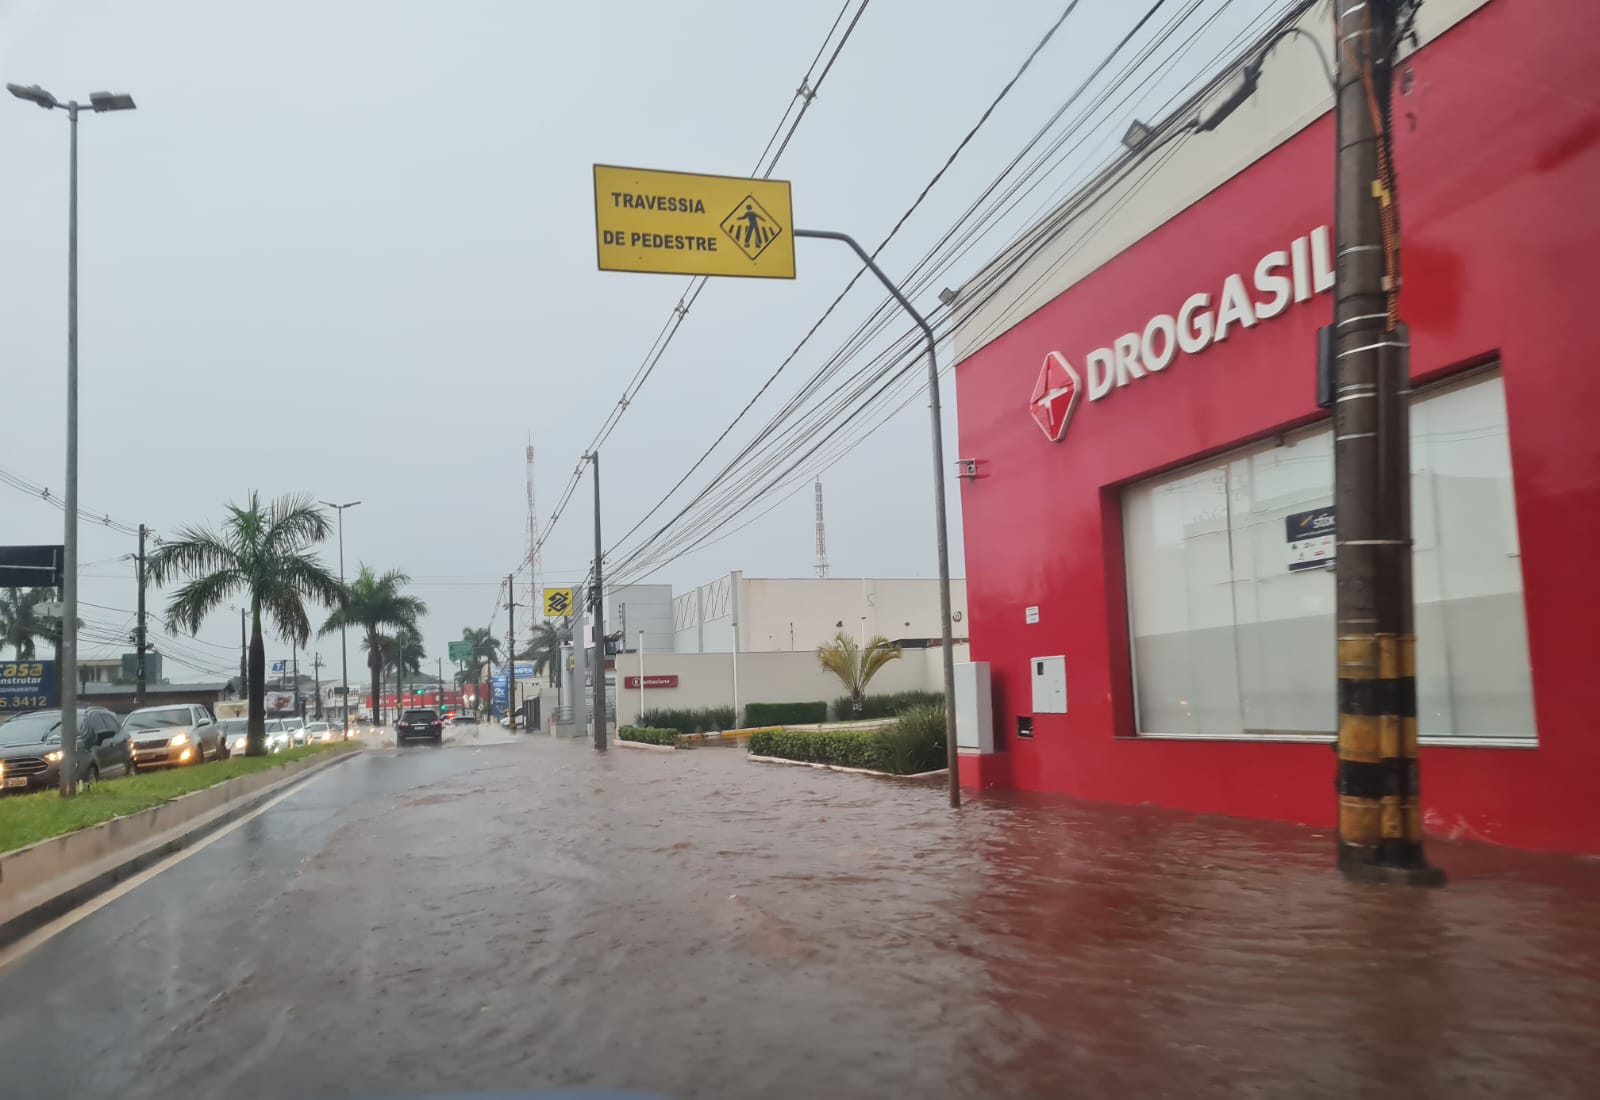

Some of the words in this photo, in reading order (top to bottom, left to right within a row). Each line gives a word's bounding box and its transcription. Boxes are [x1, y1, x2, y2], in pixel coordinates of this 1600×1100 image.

[611, 192, 706, 214] TRAVESSIA
[603, 230, 626, 246] DE
[631, 232, 718, 251] PEDESTRE
[1086, 224, 1336, 402] DROGASIL
[0, 677, 42, 685] nstrutor
